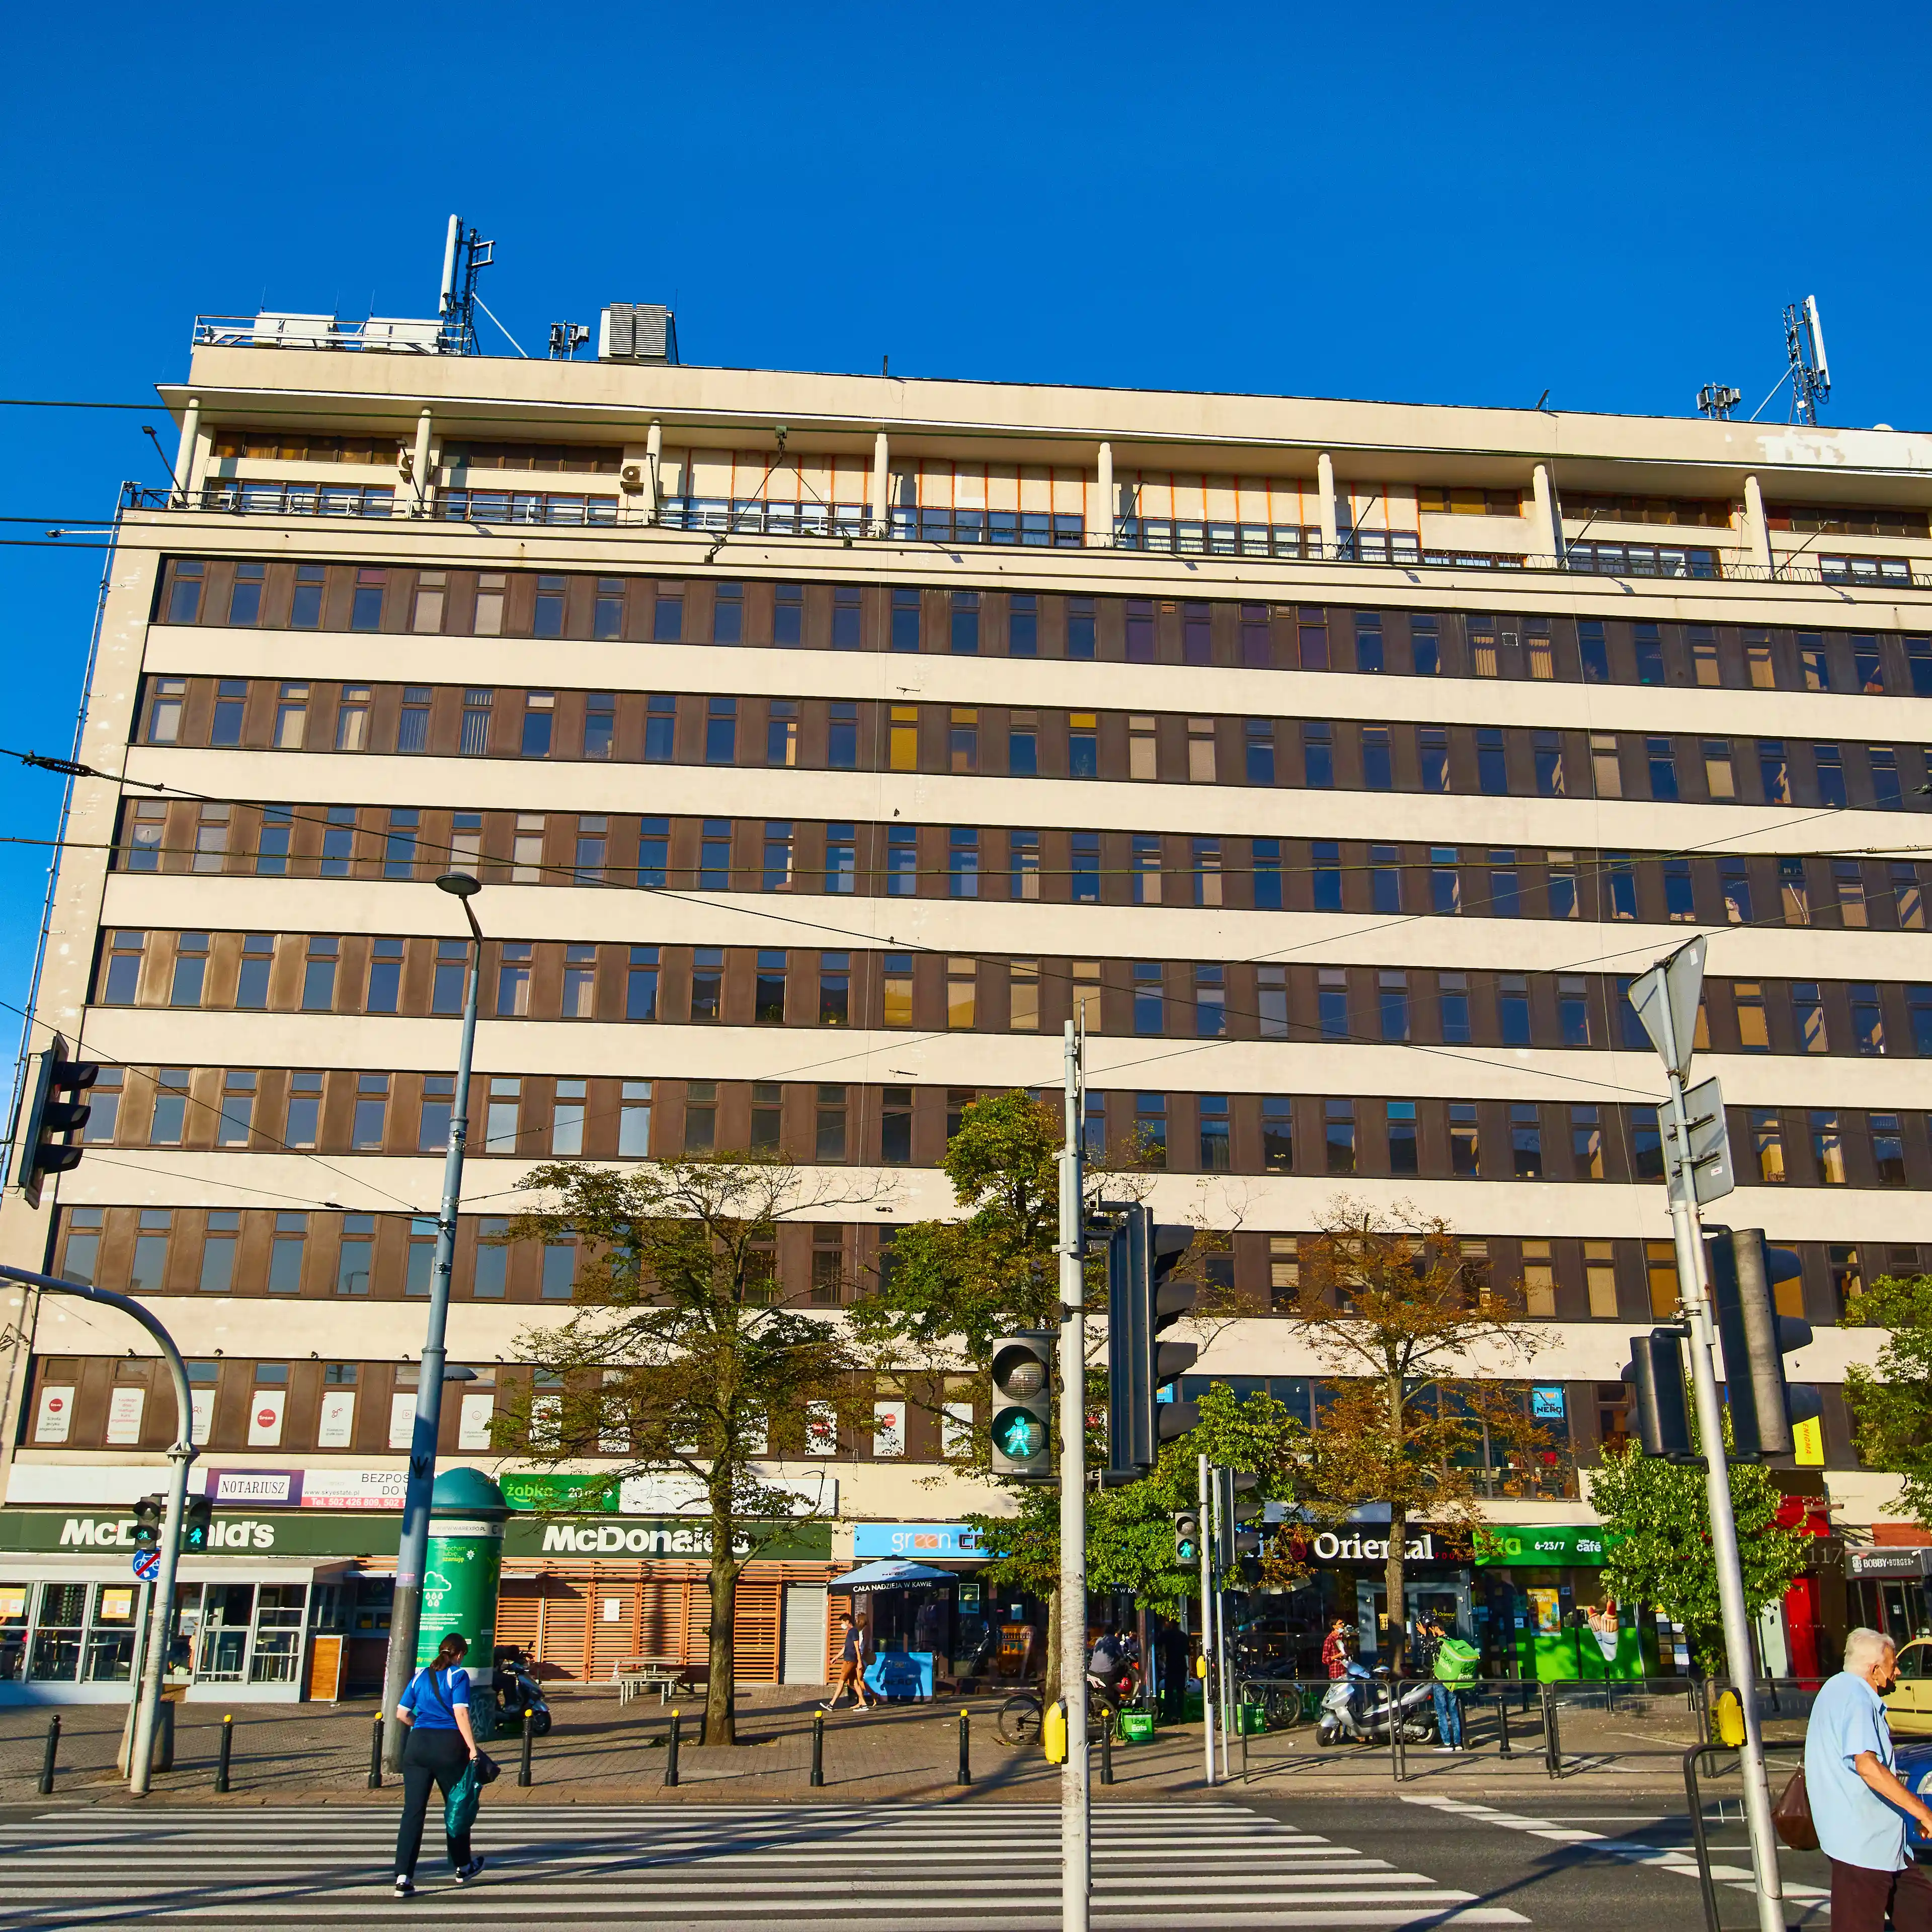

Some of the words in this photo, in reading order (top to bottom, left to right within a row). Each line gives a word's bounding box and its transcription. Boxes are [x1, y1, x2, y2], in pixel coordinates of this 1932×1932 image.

[1803, 1422, 1812, 1454] ENIGMA
[221, 1480, 286, 1494] NOTARIUSZ
[304, 1488, 360, 1496] www.skyestate.pl
[382, 1486, 399, 1495] DO
[311, 1497, 327, 1506] Tel.
[328, 1498, 344, 1506] 502
[346, 1498, 362, 1506] 426
[384, 1499, 399, 1507] 502
[59, 1519, 275, 1548] McDld's
[542, 1525, 750, 1553] McDonals
[891, 1532, 951, 1553] green
[1535, 1541, 1565, 1550] 6-23/7
[1576, 1541, 1601, 1552] café
[1435, 1552, 1455, 1560] FOO
[1809, 1548, 1843, 1564] 117
[1863, 1558, 1887, 1568] BOBBY
[871, 1582, 903, 1591] NADZIEJA
